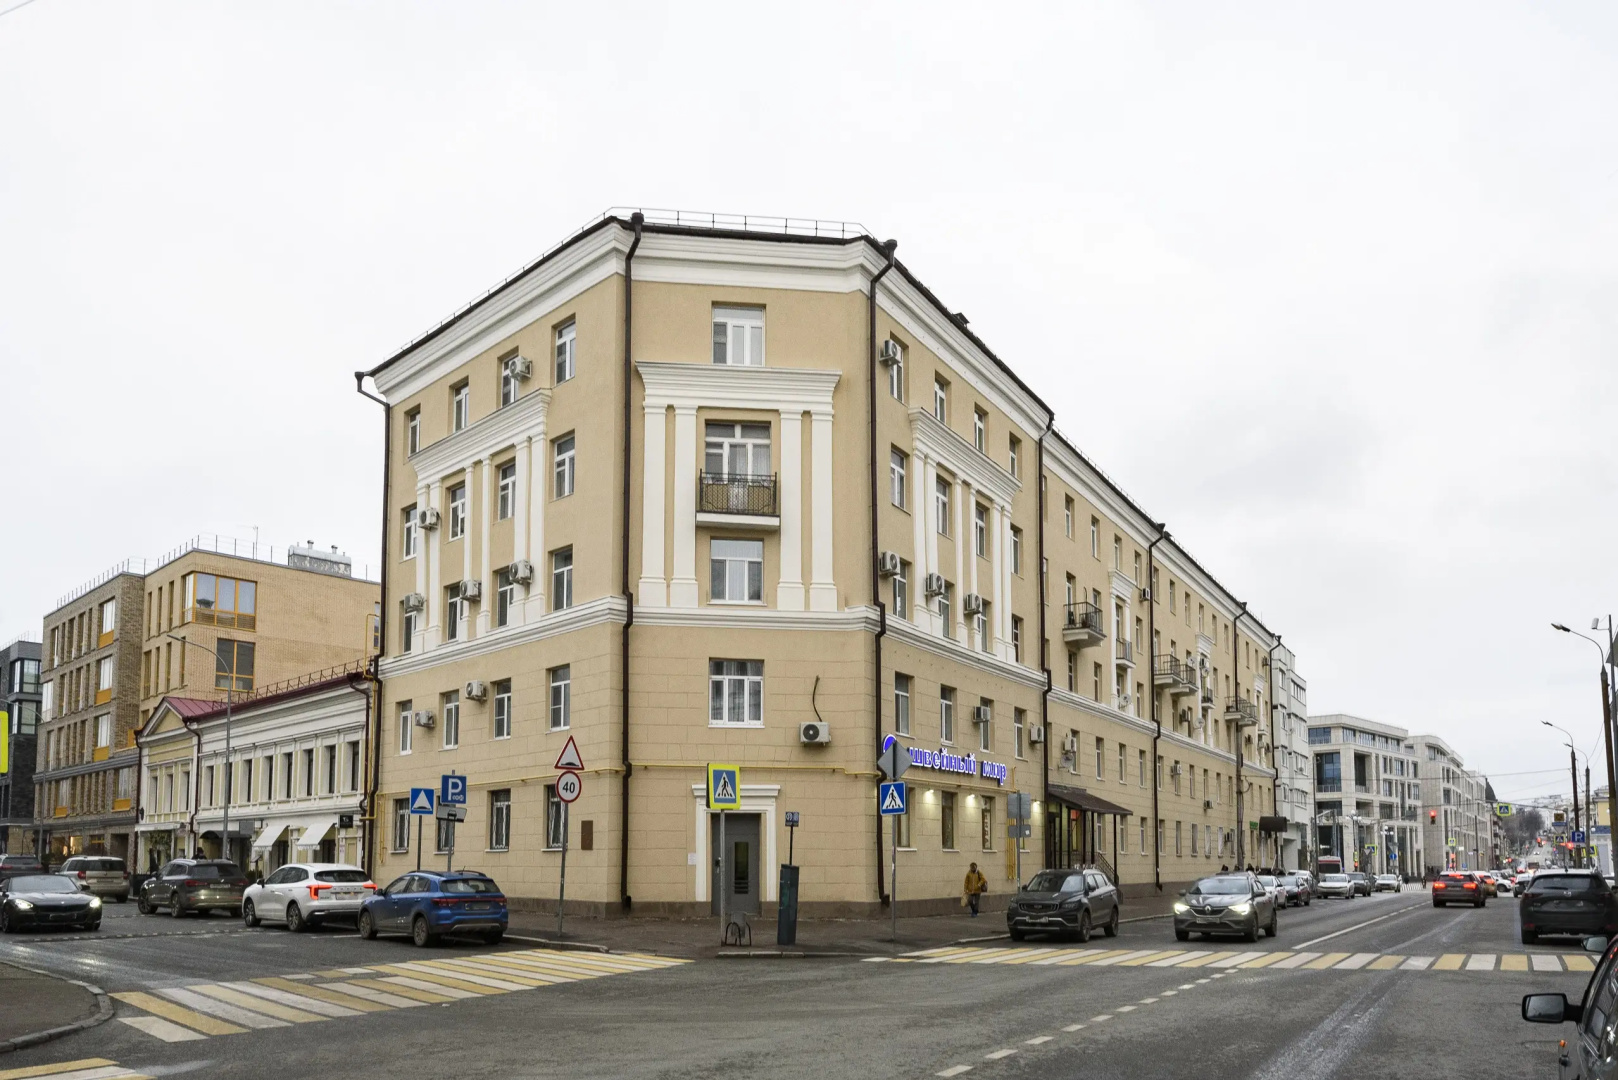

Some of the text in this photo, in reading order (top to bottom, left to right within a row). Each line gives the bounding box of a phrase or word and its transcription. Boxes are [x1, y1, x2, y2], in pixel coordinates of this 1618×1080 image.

[909, 747, 1007, 785] швейный мир
[448, 778, 462, 801] P
[562, 781, 576, 794] 40
